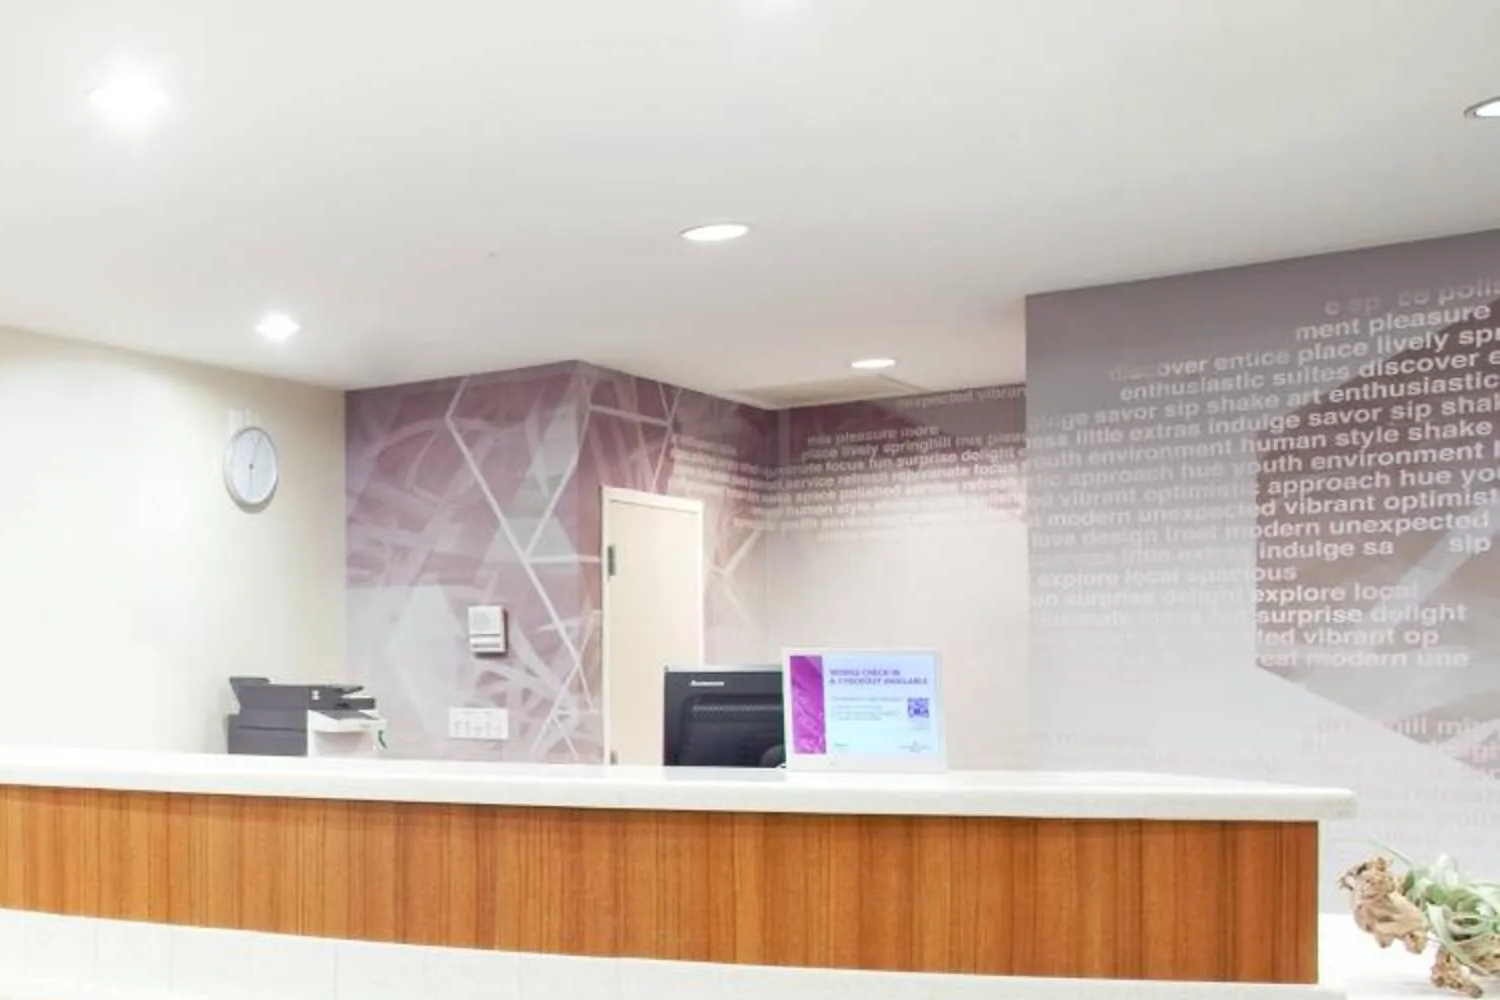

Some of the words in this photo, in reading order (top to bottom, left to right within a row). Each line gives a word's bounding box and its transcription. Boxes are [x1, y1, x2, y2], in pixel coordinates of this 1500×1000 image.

[1369, 304, 1492, 337] pleasure
[1298, 340, 1369, 367] place
[1377, 330, 1449, 354] lively
[1119, 372, 1265, 402] enthusiastic
[1272, 364, 1350, 388] suites
[1358, 351, 1481, 379] discover
[1093, 402, 1159, 425] savor
[1163, 399, 1200, 420] sip
[1206, 392, 1280, 415] shake
[1286, 387, 1322, 408] art
[1328, 371, 1500, 403] enthusiastic
[1208, 412, 1301, 437] indulge
[1307, 406, 1383, 428] savor
[1390, 400, 1433, 423] sip
[1240, 433, 1327, 454] human
[1335, 425, 1399, 450] style
[1408, 419, 1493, 442] shake
[1310, 441, 1485, 471] environment
[1267, 471, 1391, 497] approach
[1399, 467, 1452, 487] hue
[1284, 495, 1376, 516] vibrant
[1329, 509, 1489, 537] unexpected
[1259, 539, 1355, 561] indulge
[1363, 540, 1395, 556] sa
[1448, 533, 1493, 555] sip
[1253, 582, 1346, 606] explore
[1254, 604, 1364, 628] surprise
[1303, 626, 1395, 646] vibrant
[1403, 629, 1440, 649] op
